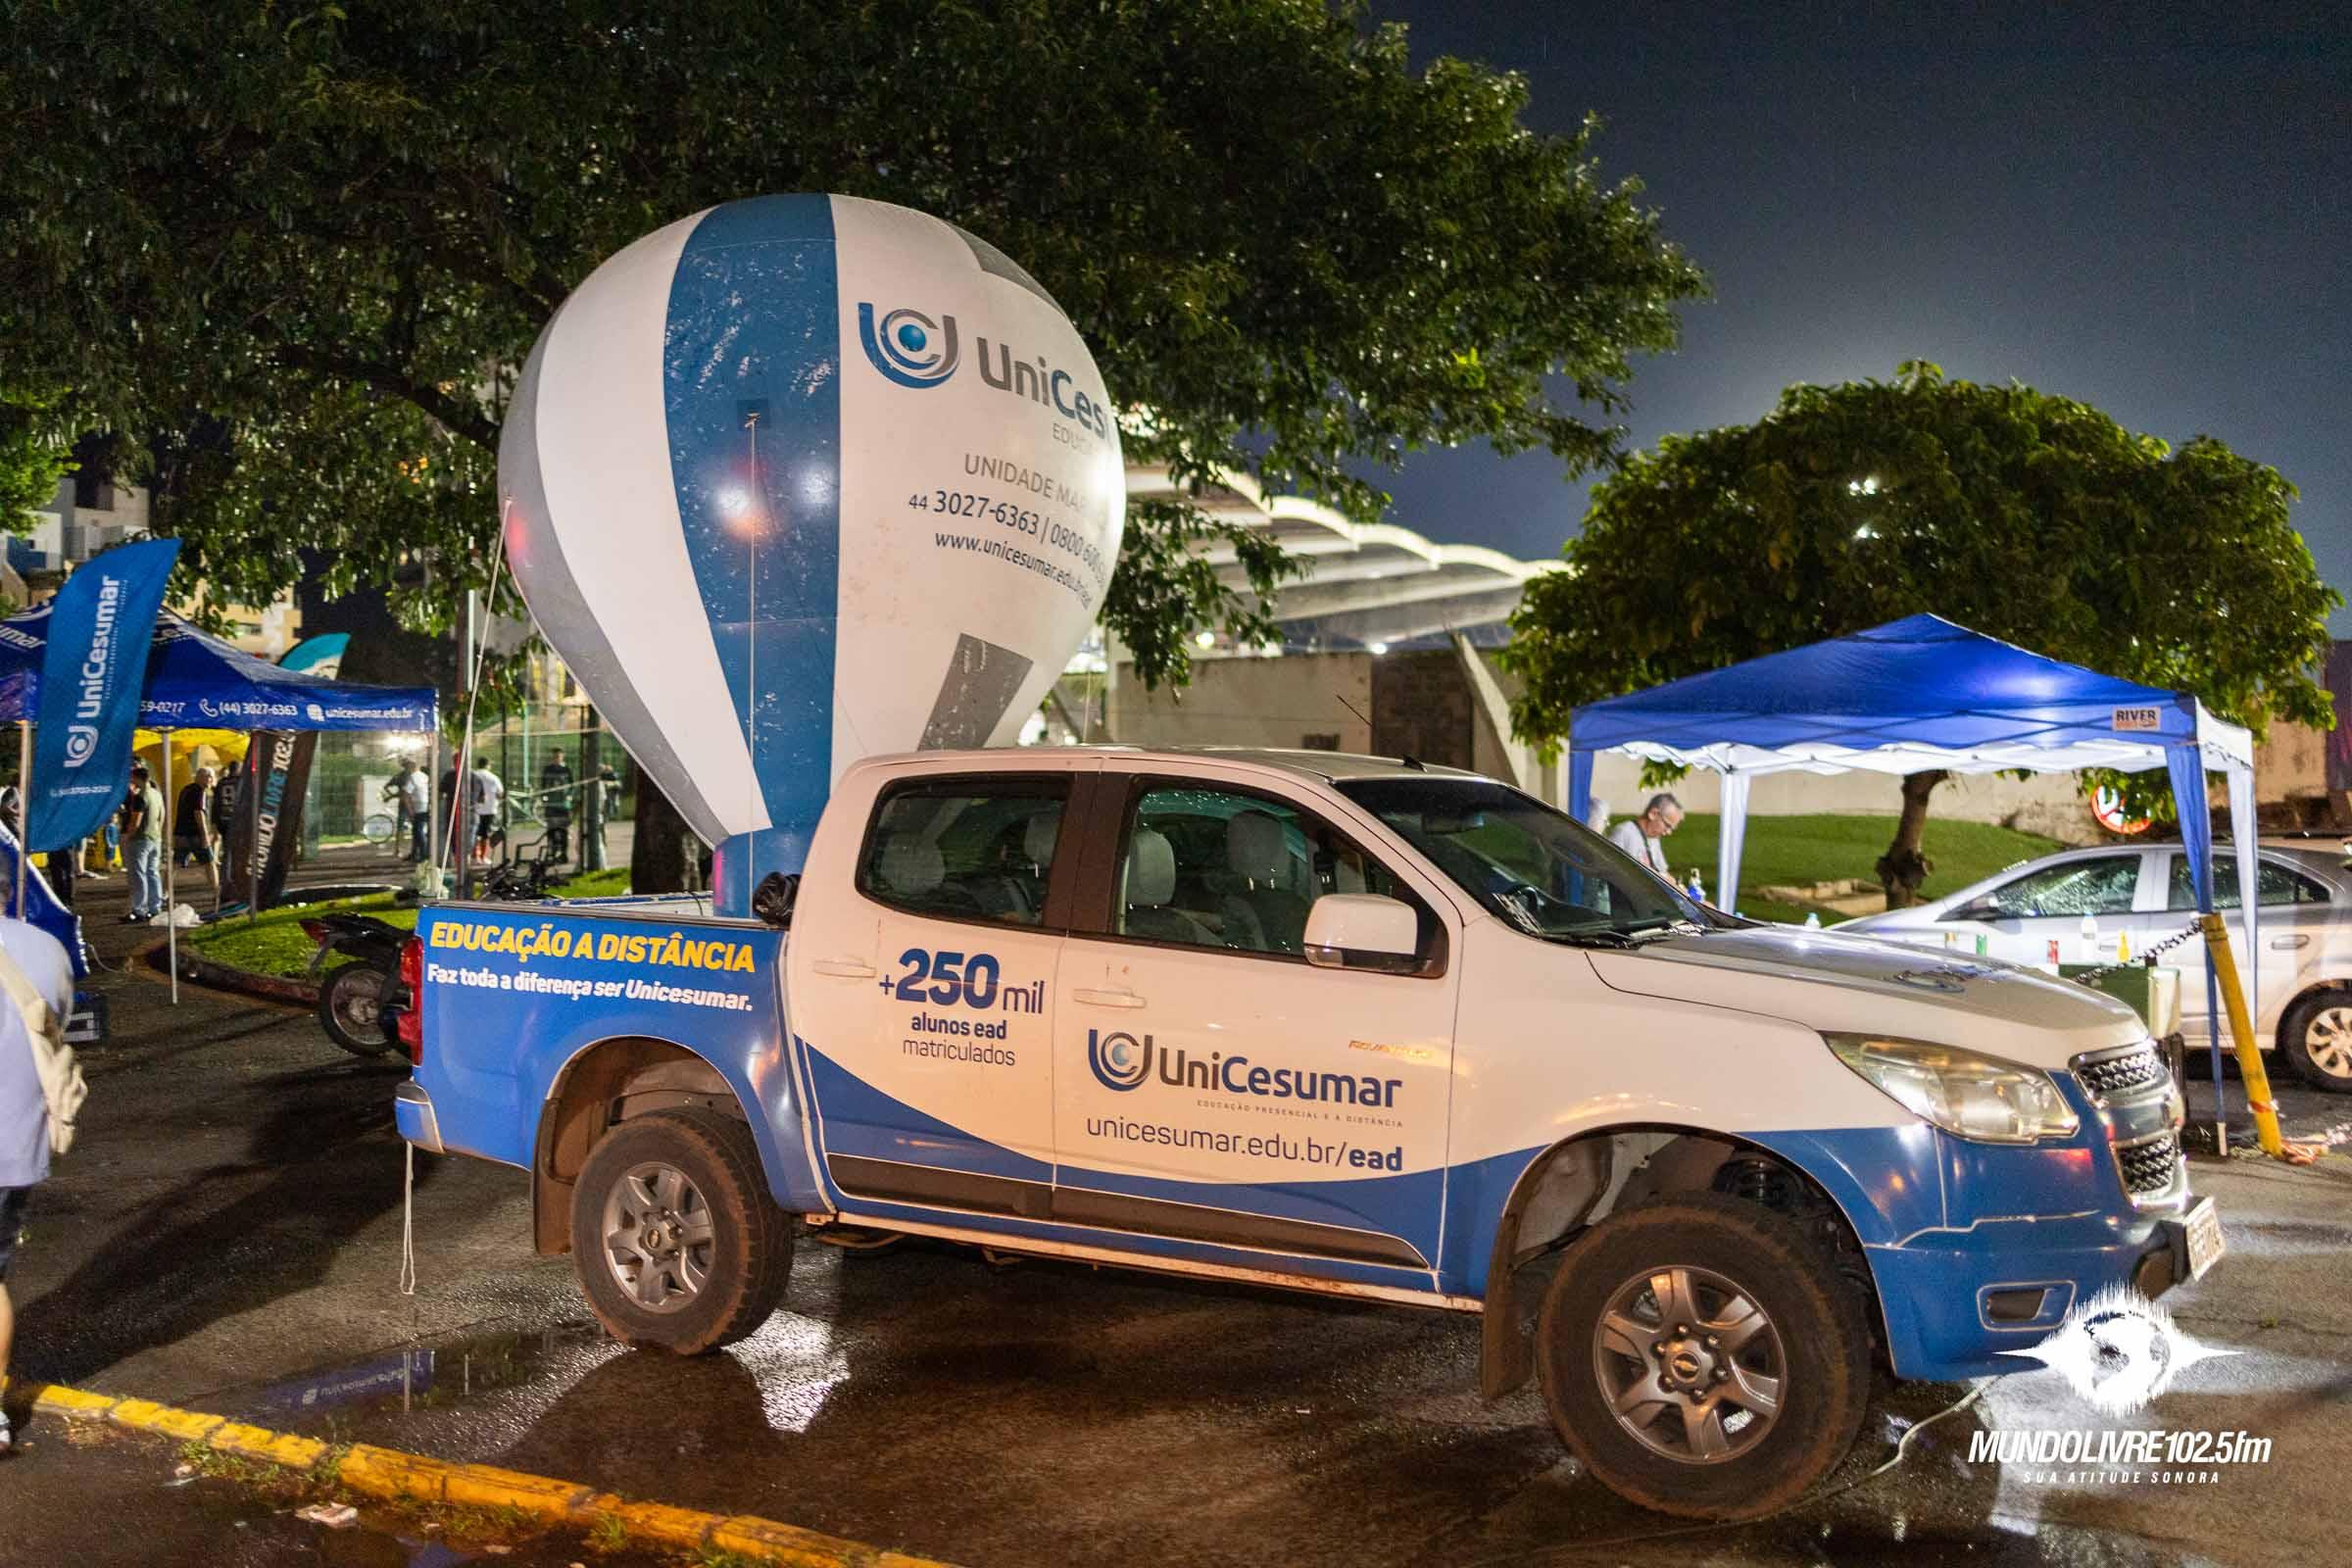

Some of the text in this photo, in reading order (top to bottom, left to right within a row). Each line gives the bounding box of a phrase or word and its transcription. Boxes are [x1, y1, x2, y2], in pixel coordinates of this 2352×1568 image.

[977, 336, 1108, 441] UniCes
[964, 453, 1054, 500] UNIDADE
[908, 490, 1083, 557] 44 3027-6363 0800
[2116, 709, 2157, 722] RIVER
[430, 921, 756, 973] EDUCAÇÃO A DISTÂNCIA
[427, 963, 754, 1011] Faz toda a diferença ser Unicesumar.
[879, 948, 1045, 1014] +250 mil
[911, 1011, 1007, 1040] alunos ead
[903, 1038, 1016, 1067] matriculados
[1159, 1047, 1402, 1108] UniCesumar
[1254, 1106, 1317, 1120] PRESENCIAL
[1087, 1116, 1402, 1172] unicesumar.edu.br/ead
